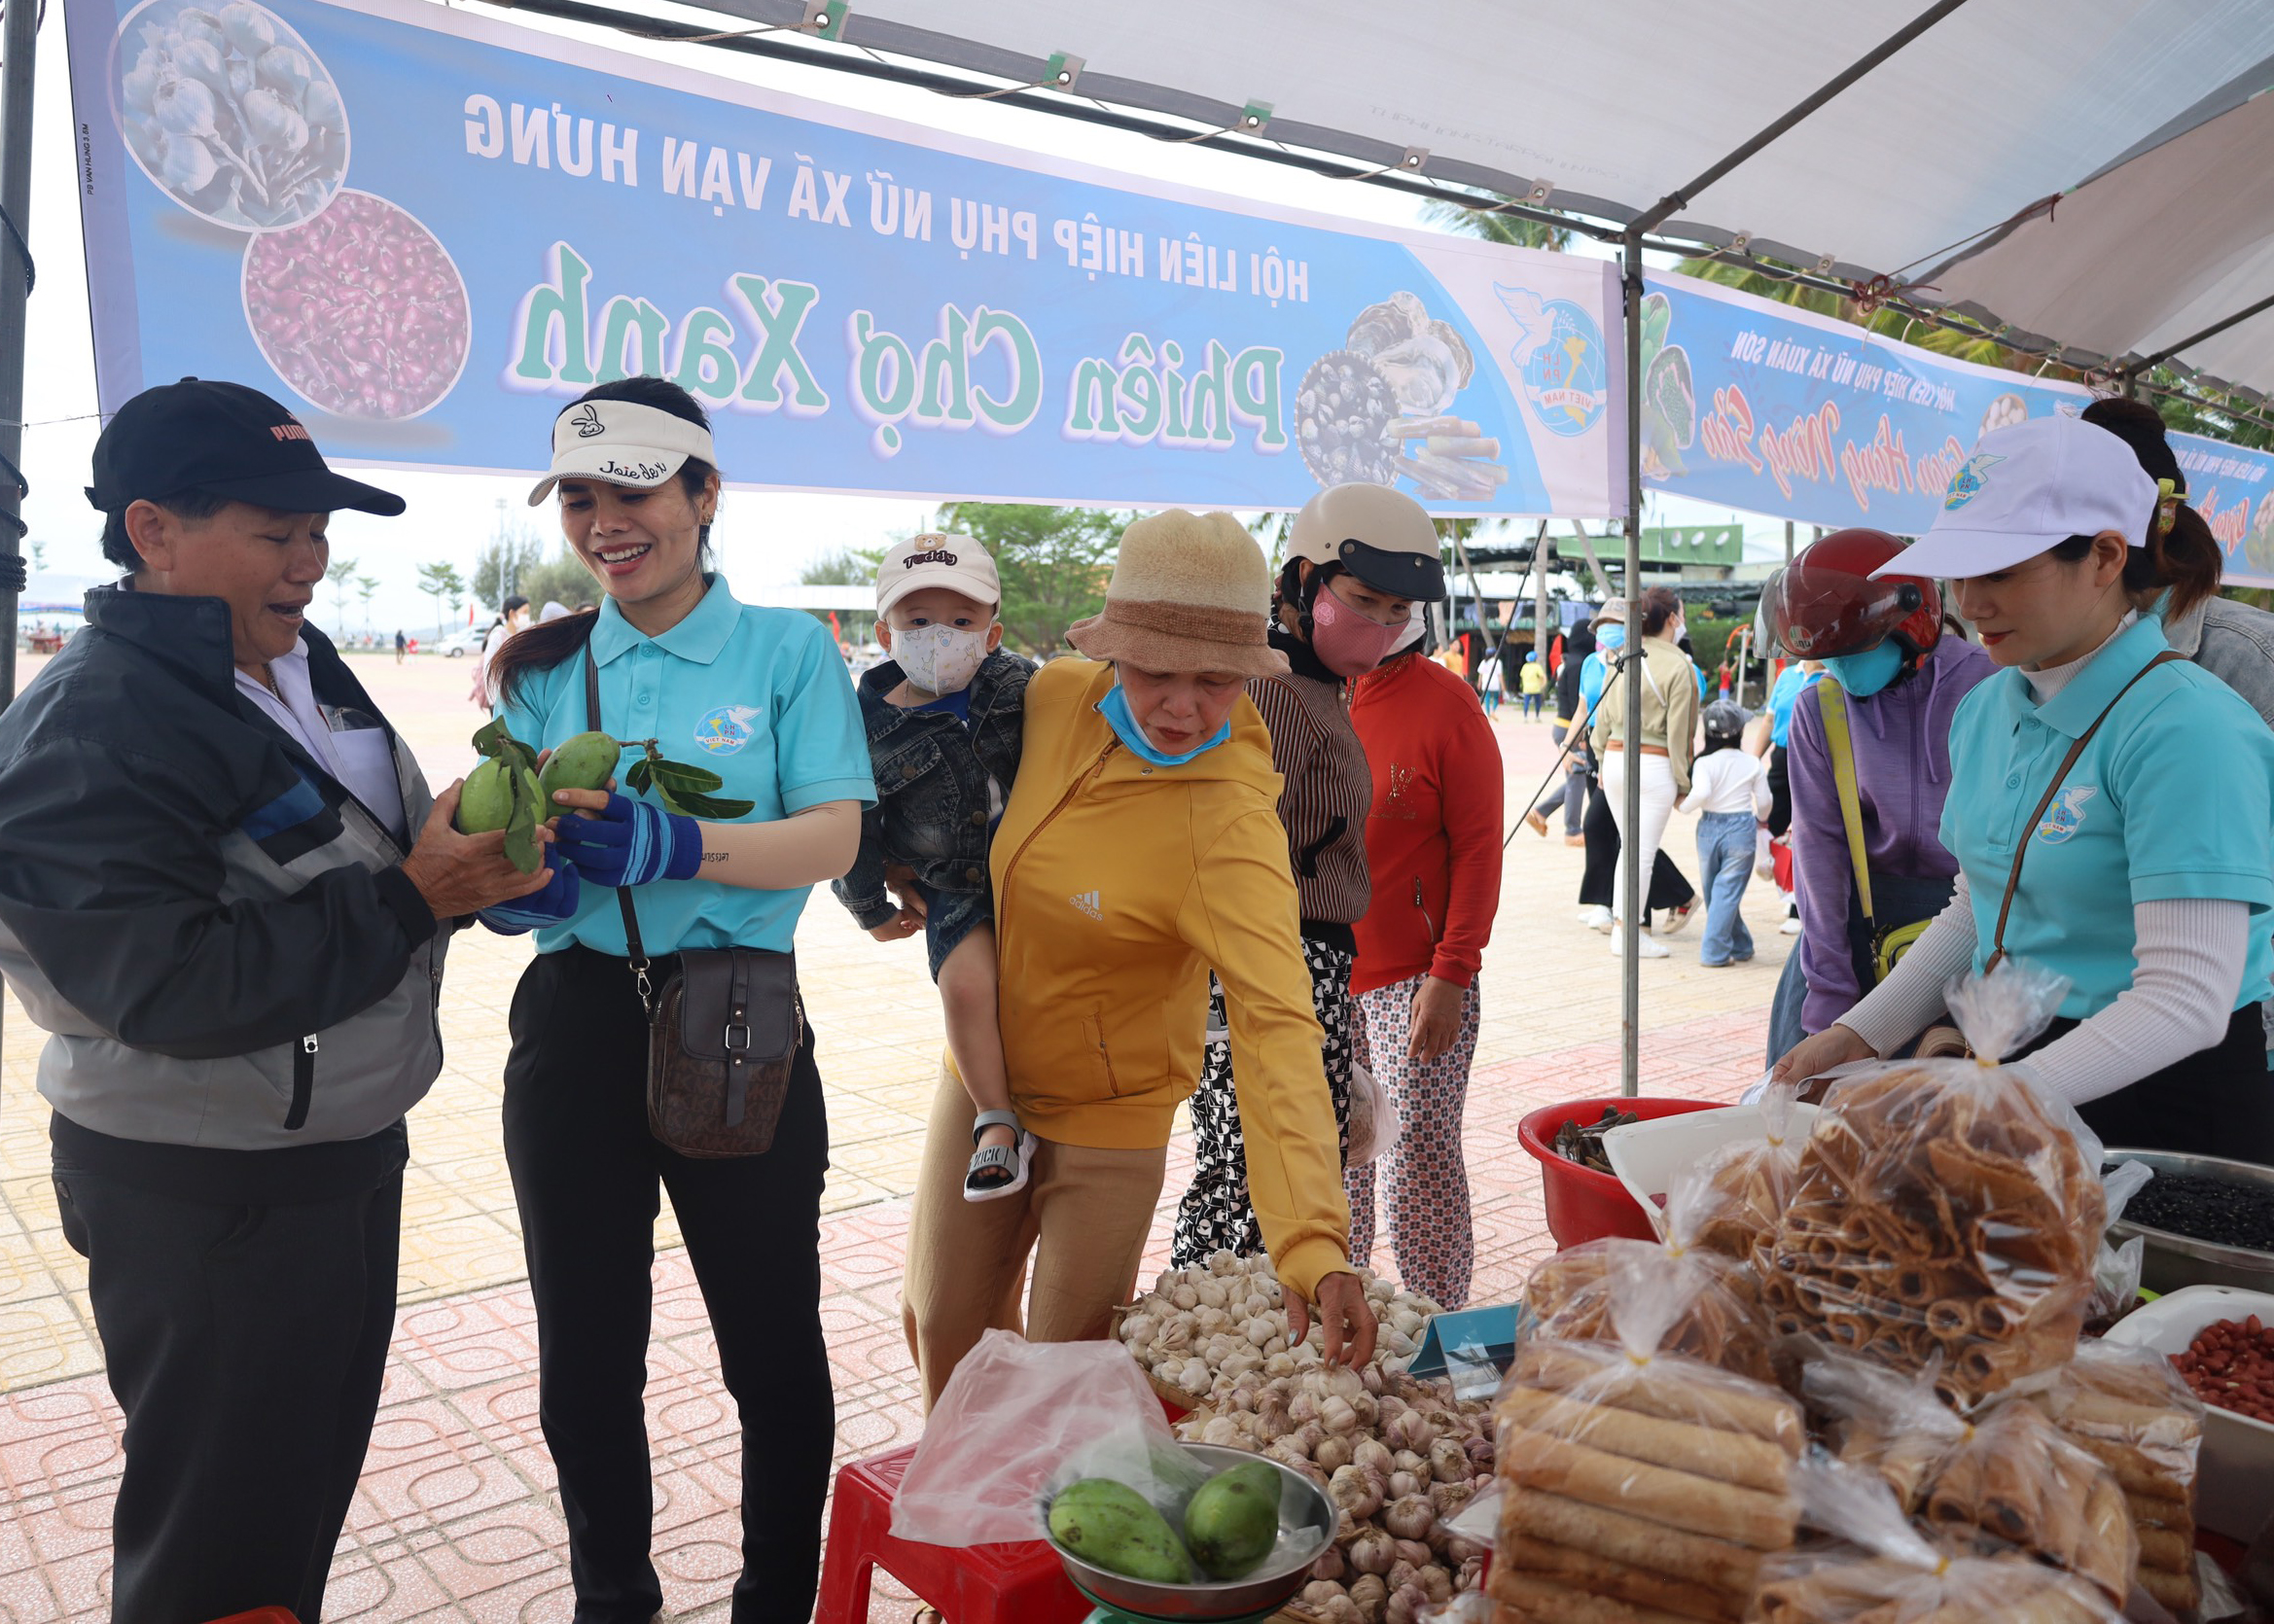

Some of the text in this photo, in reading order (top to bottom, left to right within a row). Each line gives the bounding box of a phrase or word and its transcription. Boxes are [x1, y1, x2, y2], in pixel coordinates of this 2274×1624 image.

[269, 424, 313, 441] PUM
[599, 460, 640, 480] Joie
[638, 463, 659, 480] de
[903, 549, 958, 569] Teddy
[1069, 897, 1104, 922] adidas
